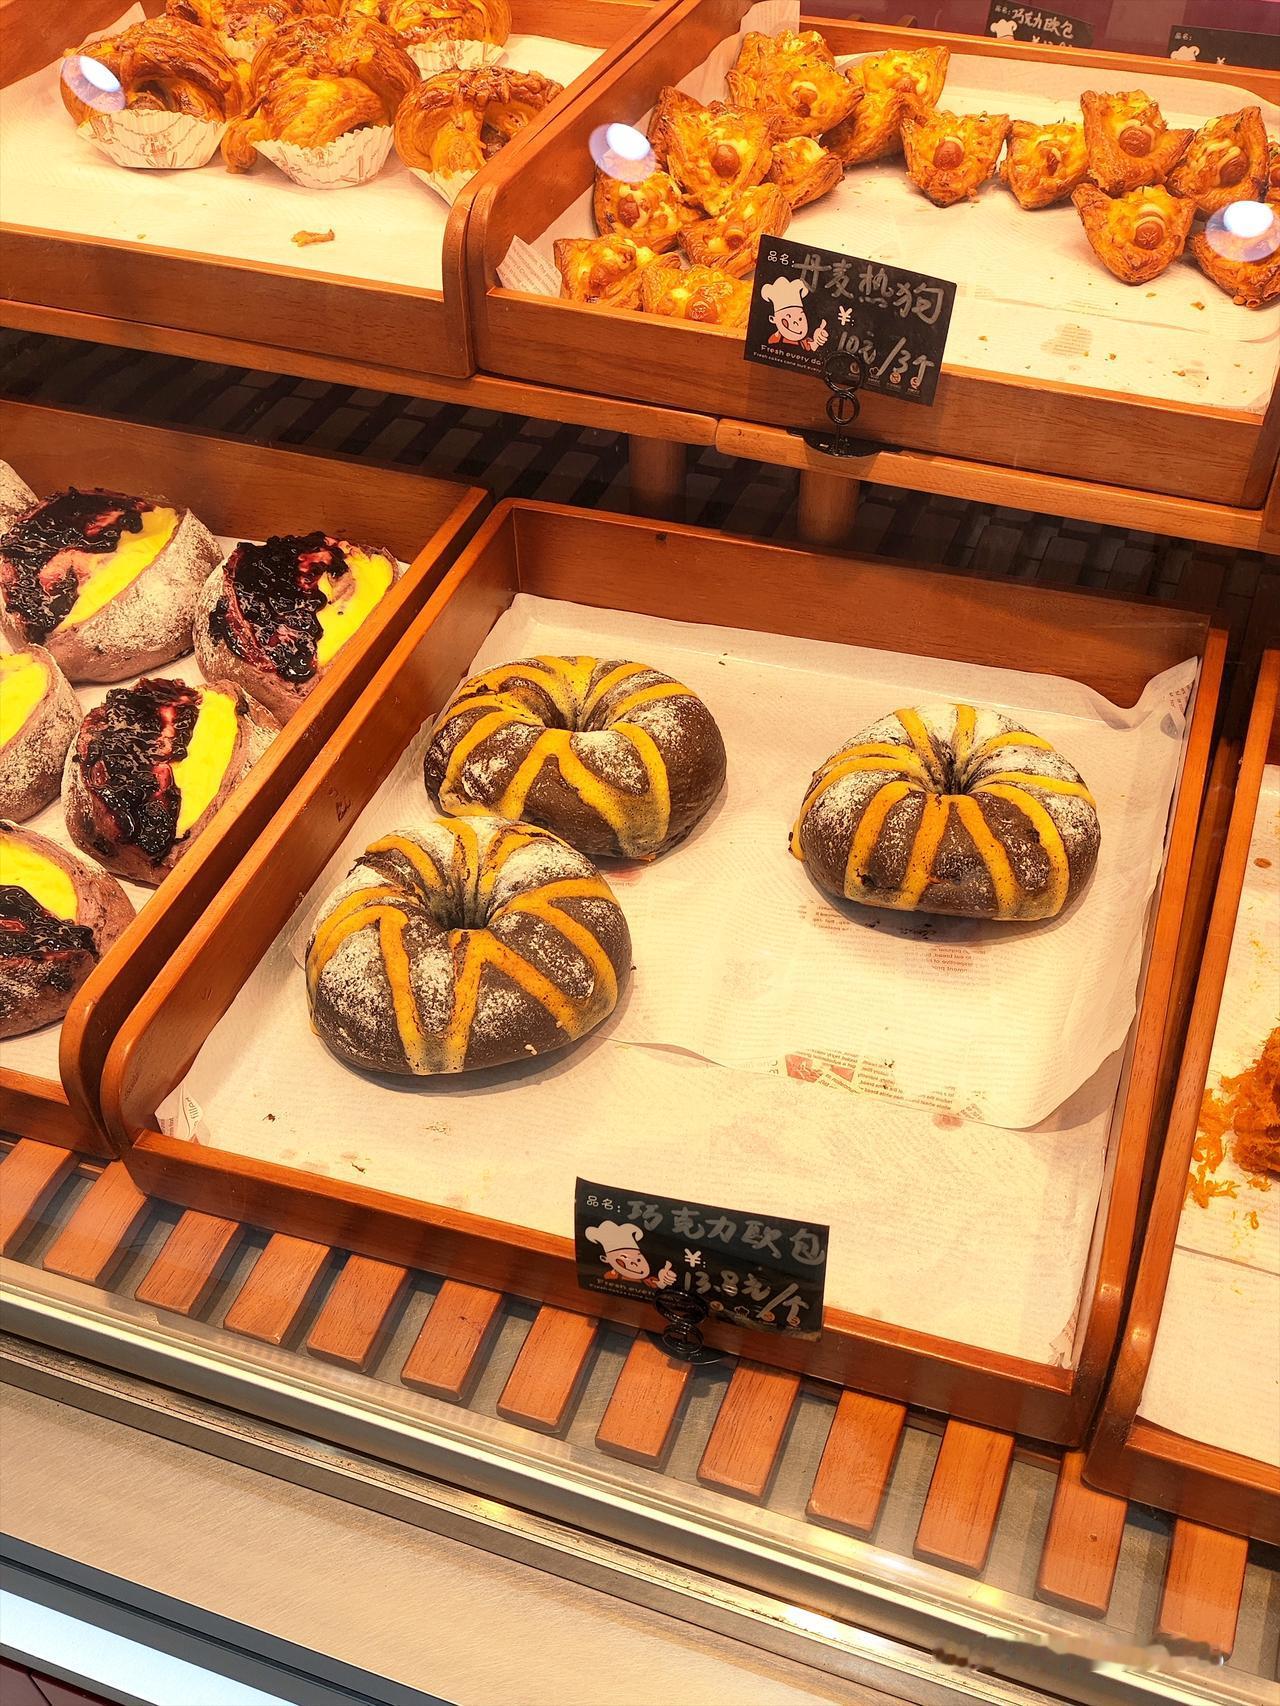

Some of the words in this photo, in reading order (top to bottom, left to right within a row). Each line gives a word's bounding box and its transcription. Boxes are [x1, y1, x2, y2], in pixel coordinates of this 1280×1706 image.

[760, 344, 785, 357] Fresh
[626, 1200, 825, 1266] 巧克力欧包
